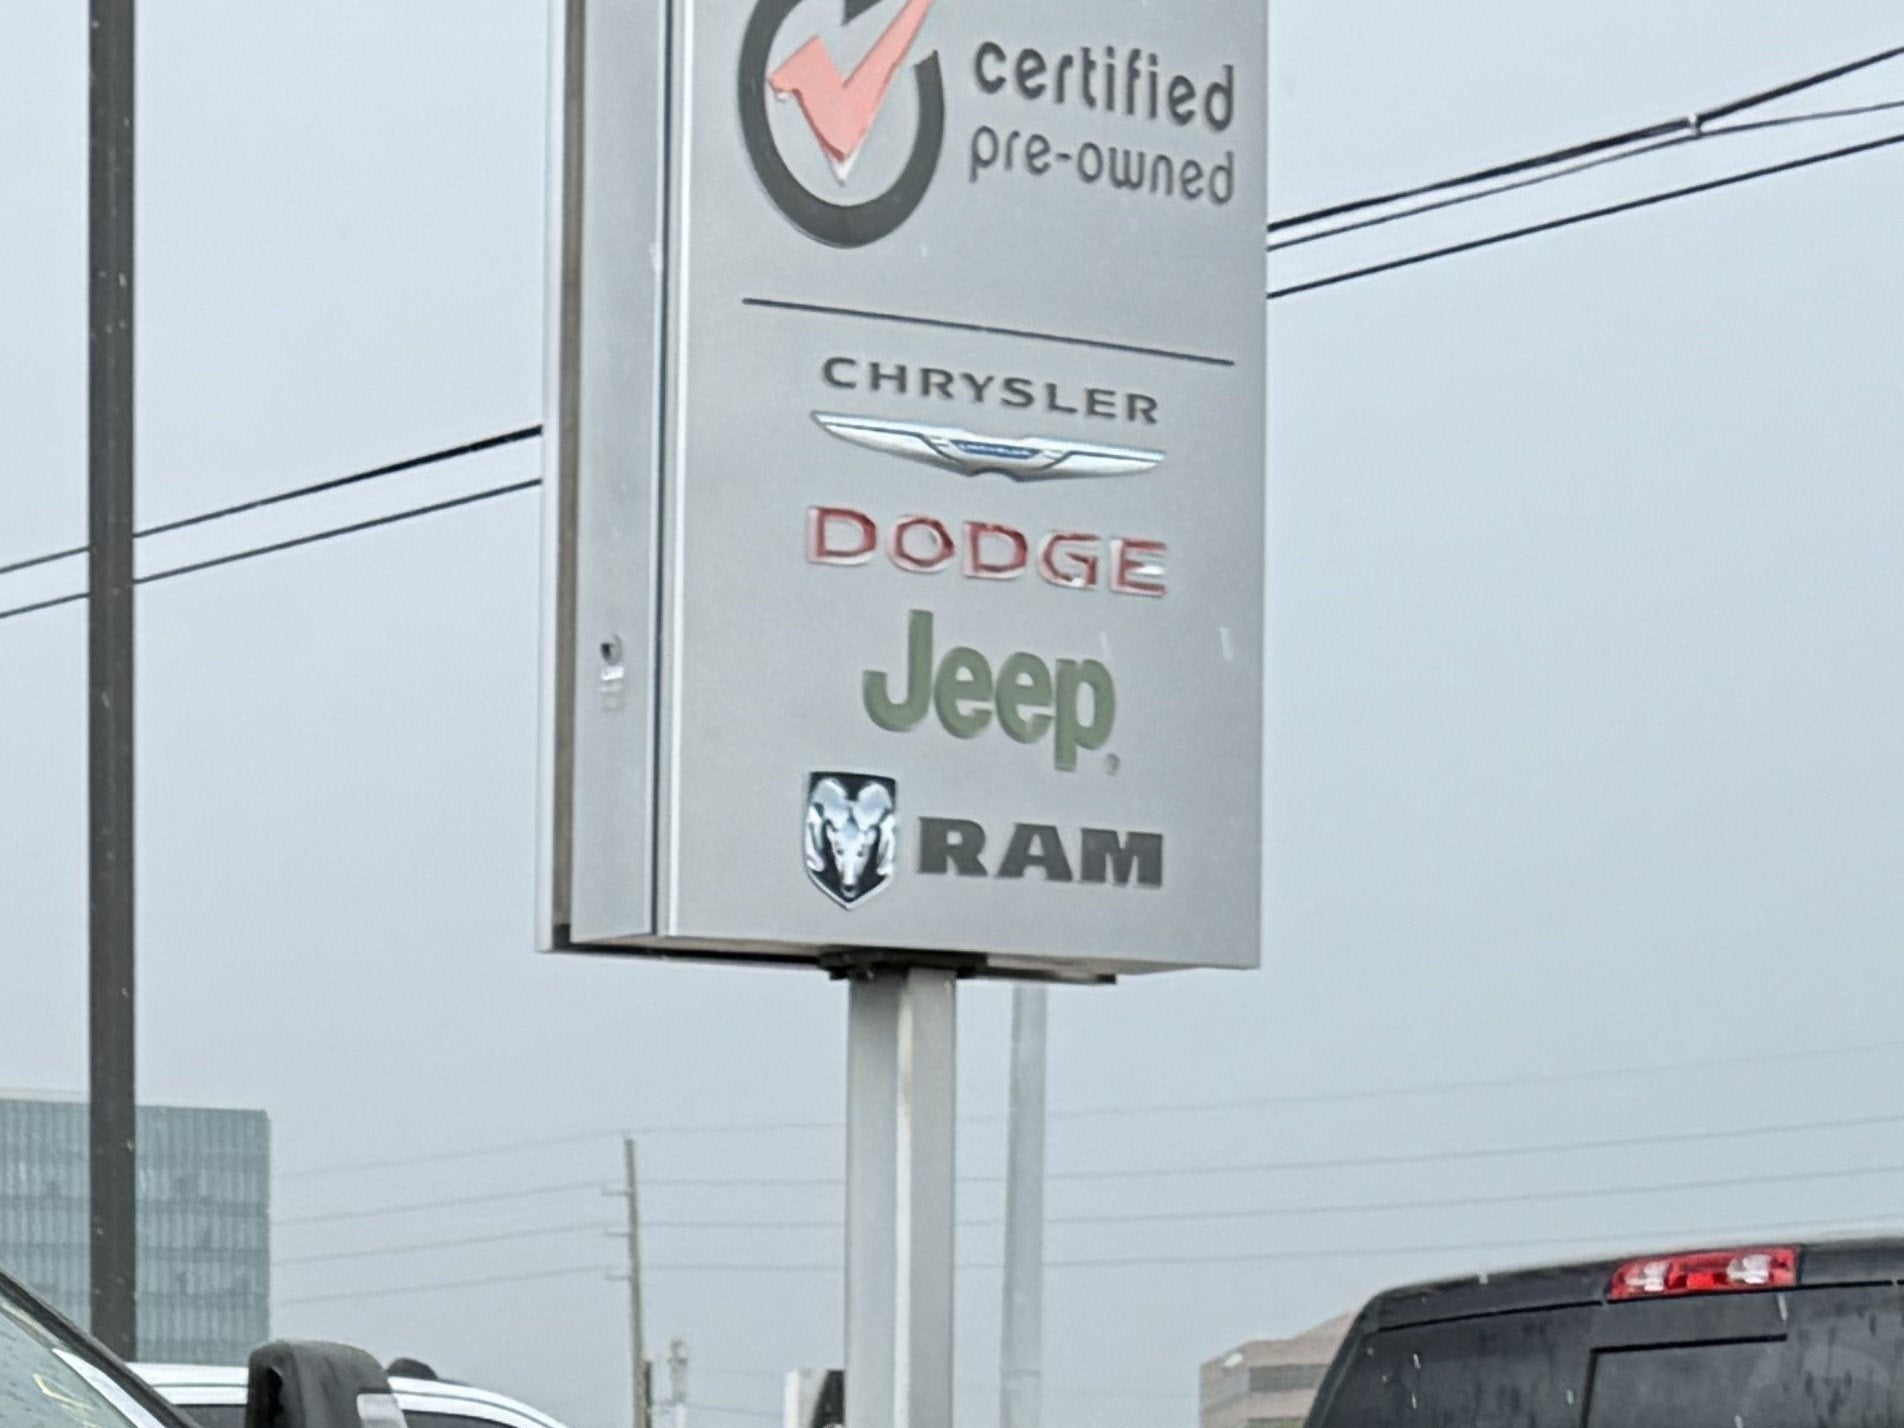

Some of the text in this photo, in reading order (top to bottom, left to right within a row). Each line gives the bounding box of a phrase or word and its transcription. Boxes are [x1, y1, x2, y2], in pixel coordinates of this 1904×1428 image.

[973, 41, 1235, 131] certified
[969, 124, 1234, 205] pre-owned
[822, 356, 1159, 425] CHRYSLER
[806, 505, 1167, 598] DODGE
[862, 609, 1117, 772] Jeep
[918, 815, 1164, 888] RAM
